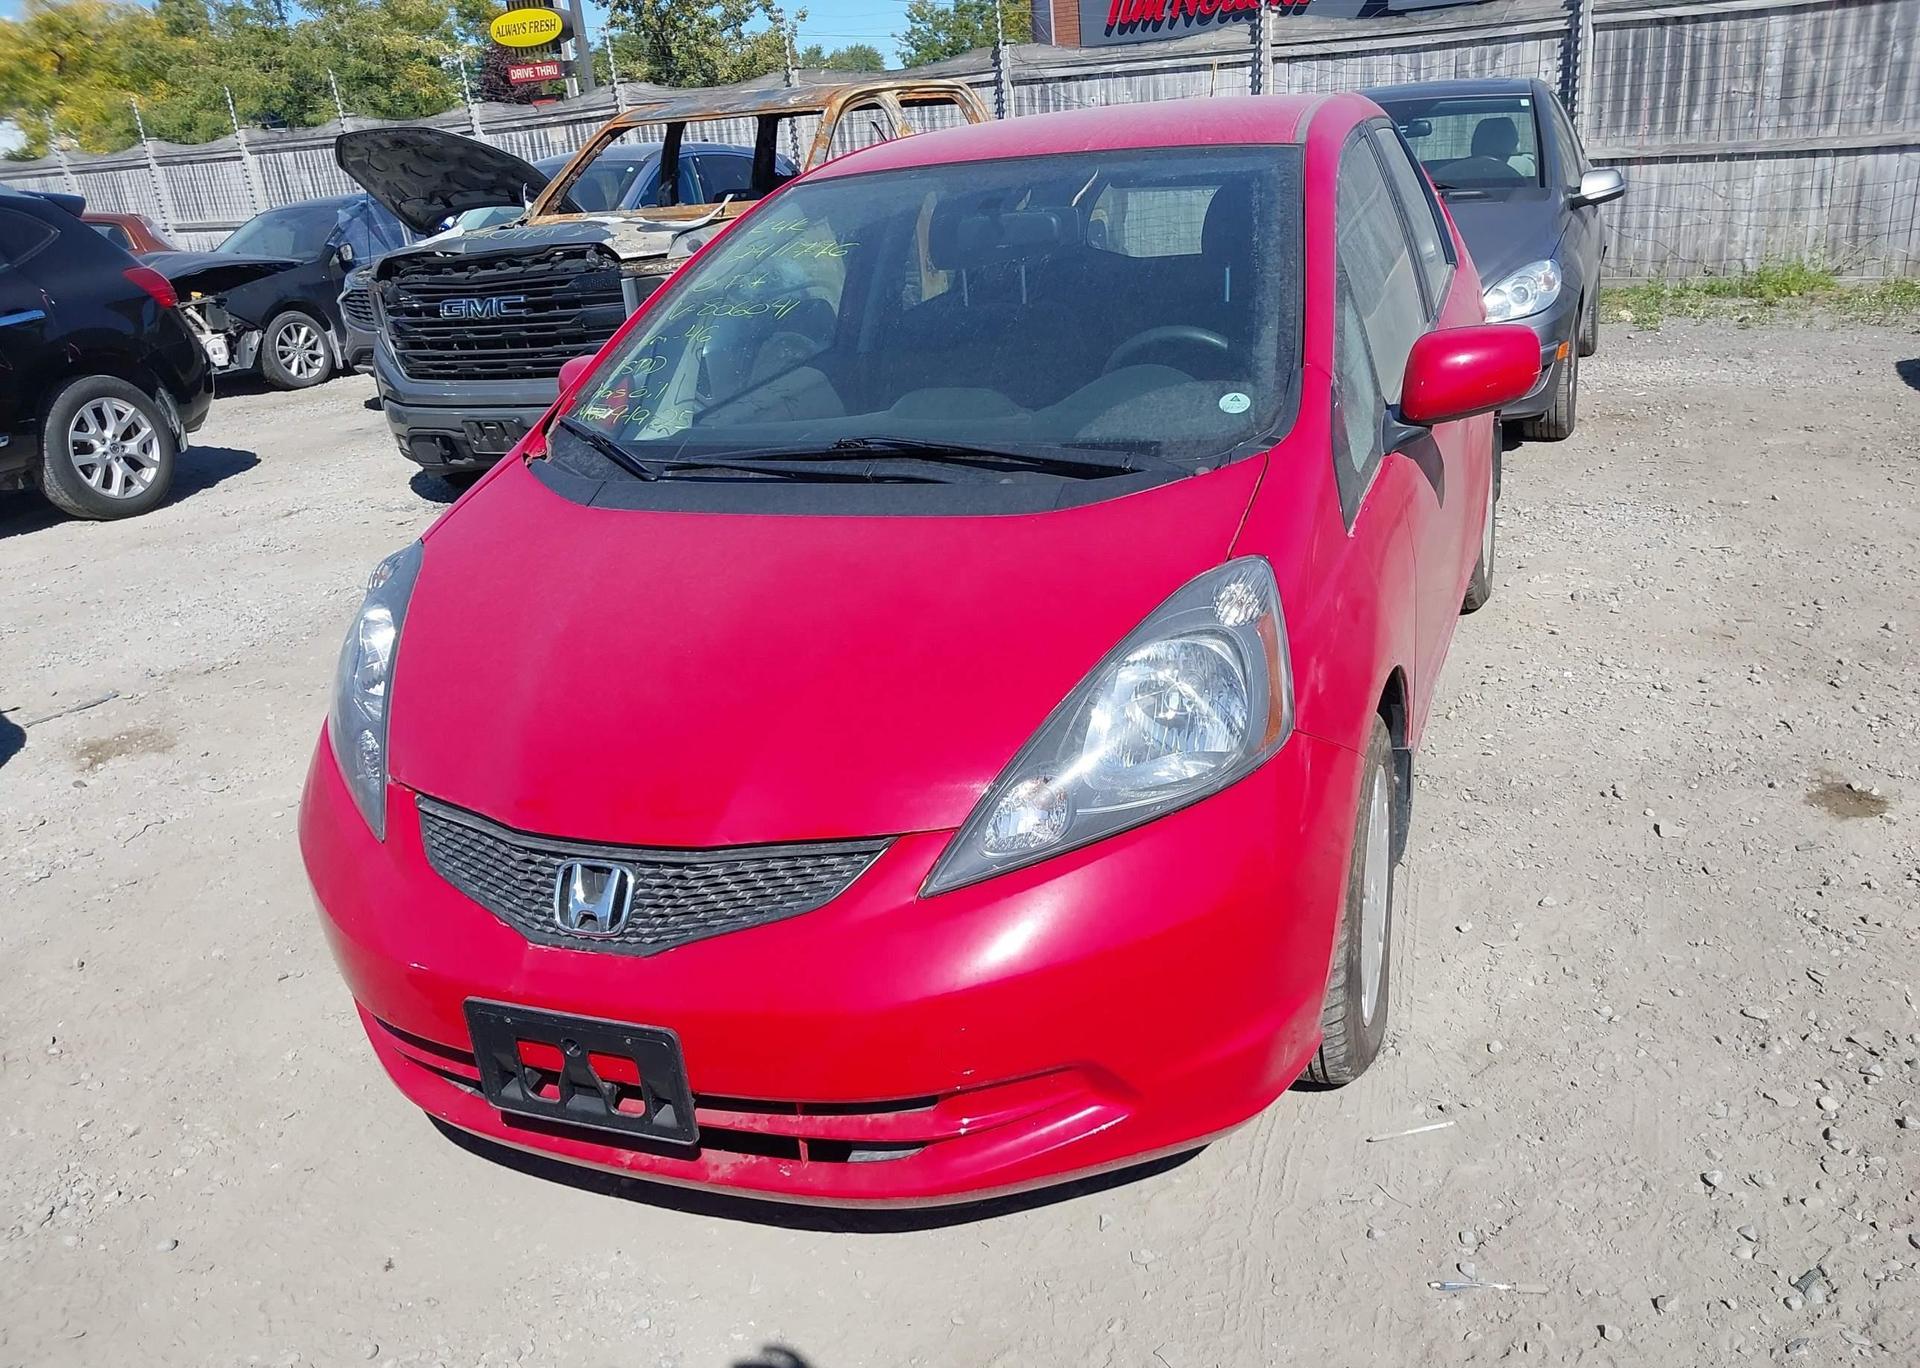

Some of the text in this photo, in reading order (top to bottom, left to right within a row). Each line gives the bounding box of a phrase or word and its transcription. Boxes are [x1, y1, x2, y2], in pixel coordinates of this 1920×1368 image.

[495, 18, 557, 38] ALWAYS FRESH
[510, 65, 558, 80] DRIVE THRU
[440, 295, 525, 319] GMC
